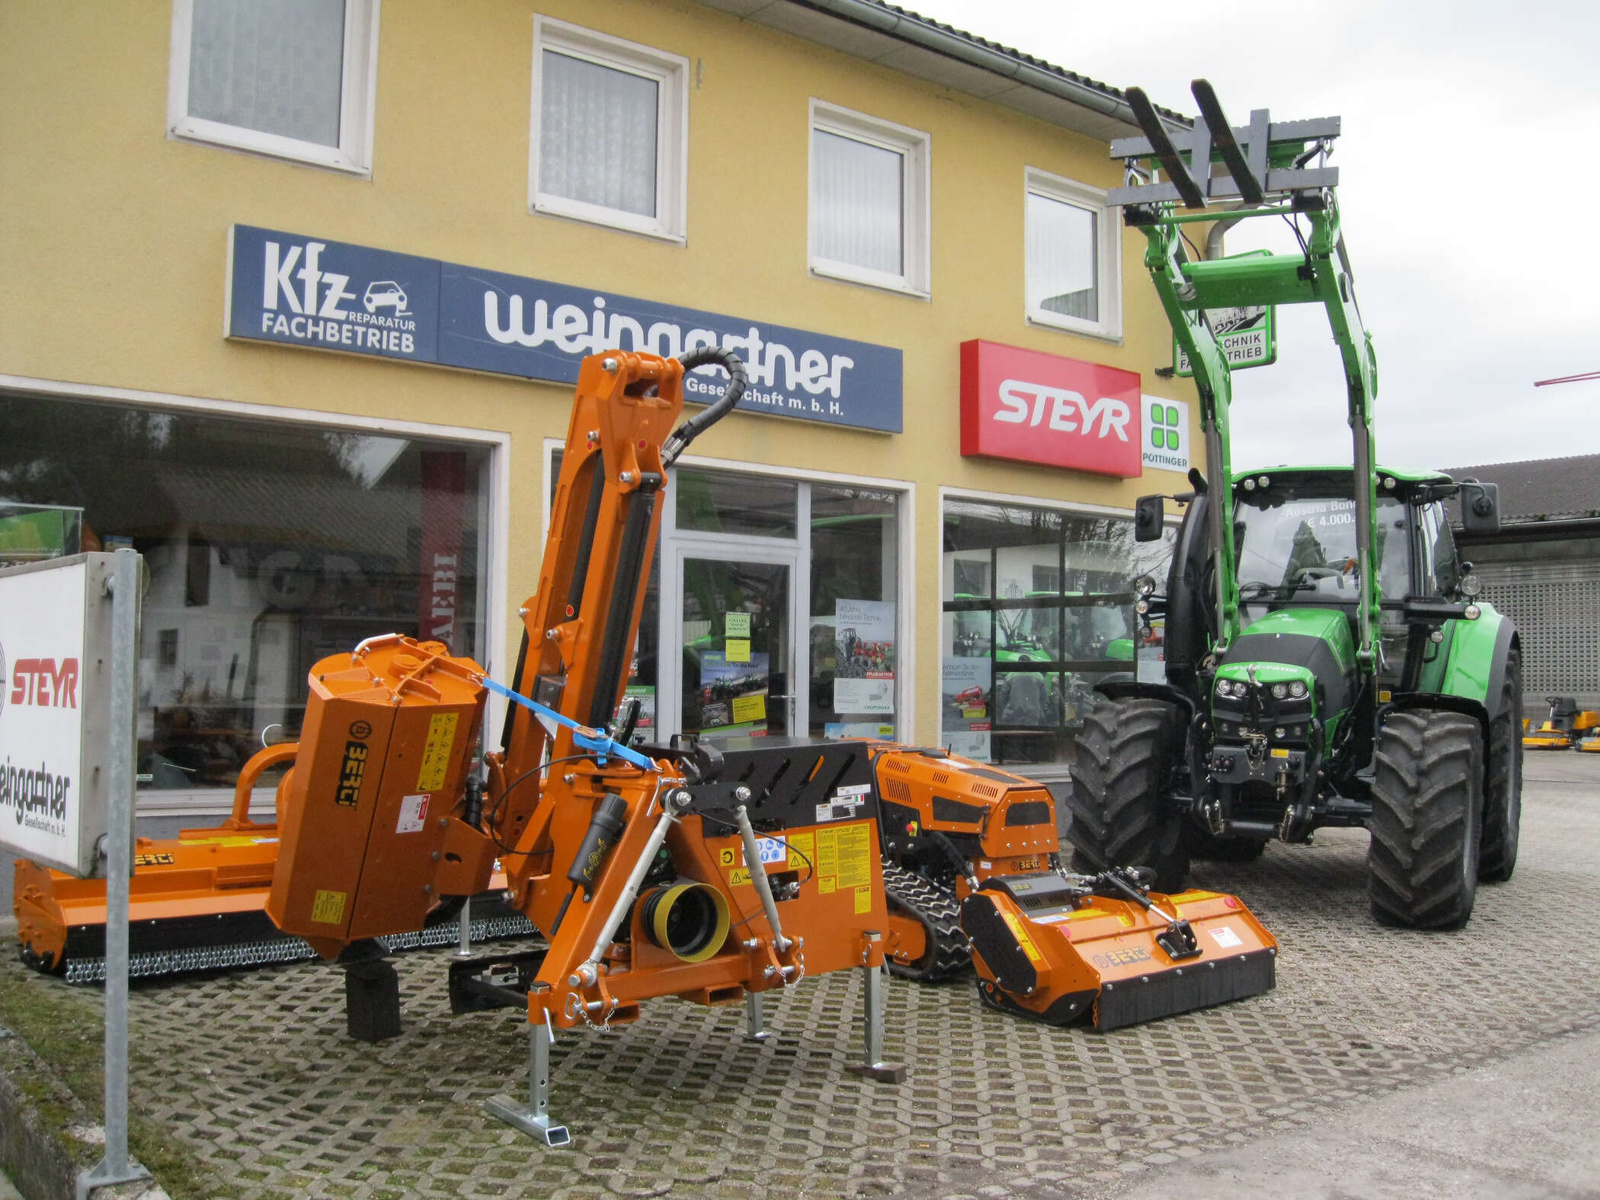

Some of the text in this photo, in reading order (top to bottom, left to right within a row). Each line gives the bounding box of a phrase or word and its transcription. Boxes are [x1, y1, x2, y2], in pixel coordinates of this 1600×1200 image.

[263, 241, 356, 320] Kfz
[262, 312, 415, 354] FACHBETRIEB
[349, 311, 416, 332] REPARATUR
[788, 397, 806, 410] m.
[811, 400, 824, 413] b.
[829, 401, 844, 416] H.
[993, 379, 1131, 442] STEYR
[431, 553, 457, 647] AEBI
[10, 657, 79, 709] STEYR
[0, 755, 71, 825] eingartner
